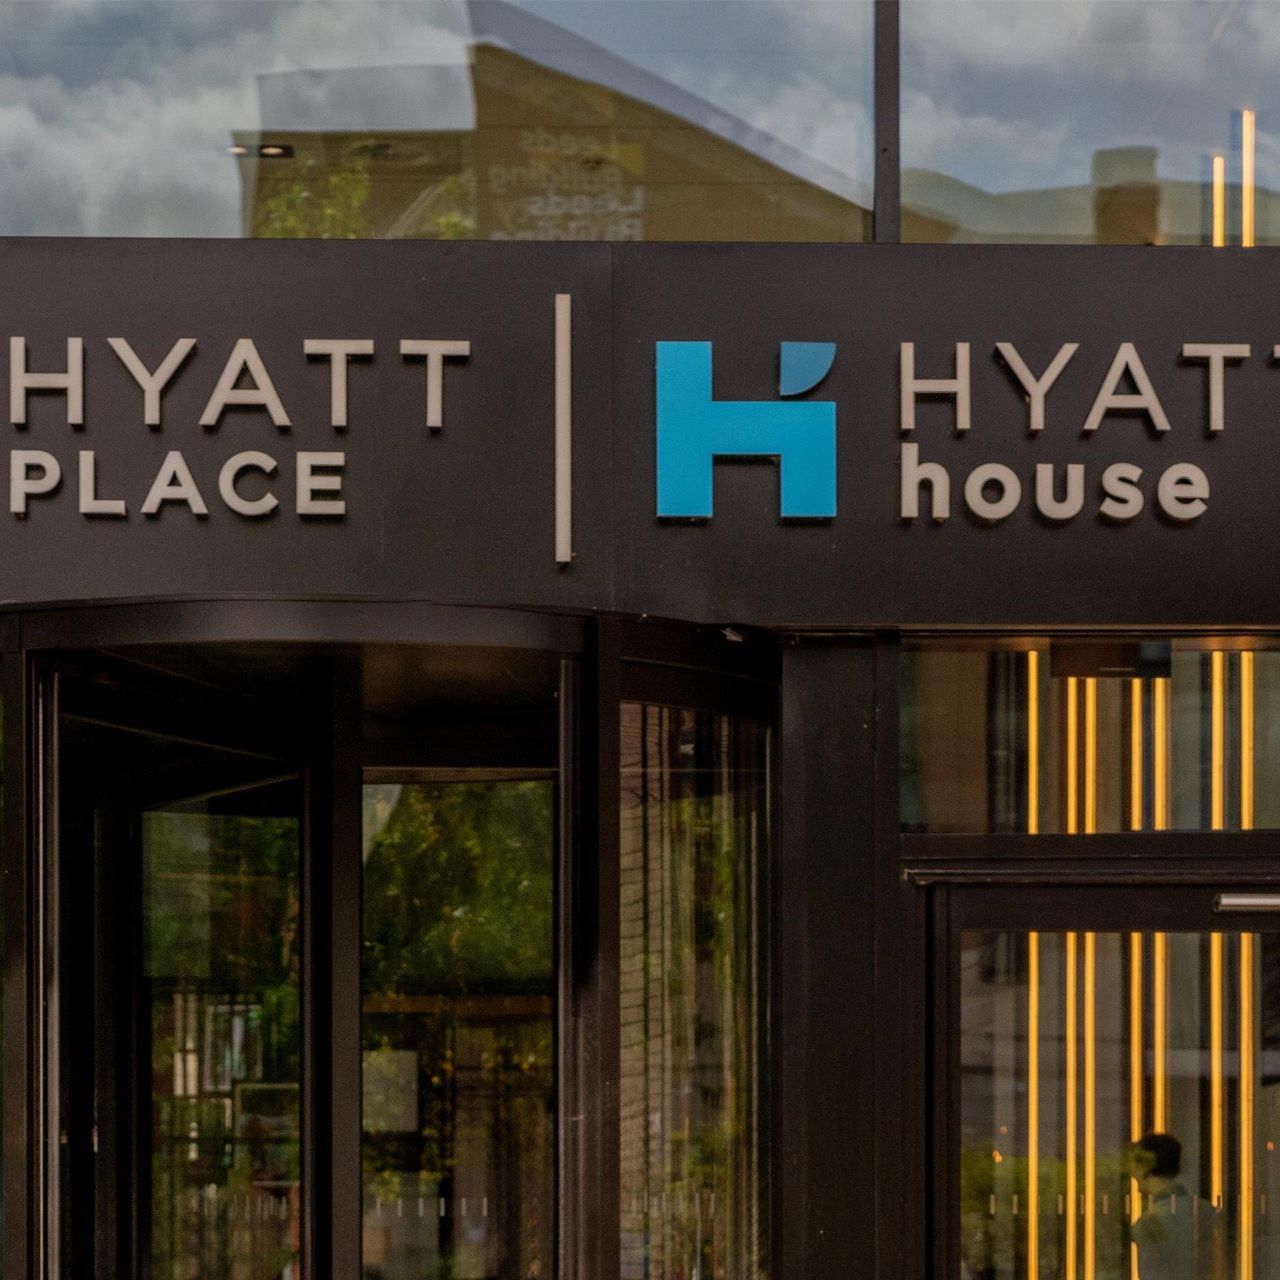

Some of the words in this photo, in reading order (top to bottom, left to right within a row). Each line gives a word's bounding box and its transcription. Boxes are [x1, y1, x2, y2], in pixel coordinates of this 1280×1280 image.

[10, 336, 471, 427] HYATT
[10, 450, 346, 516] PLACE
[900, 442, 1210, 520] house
